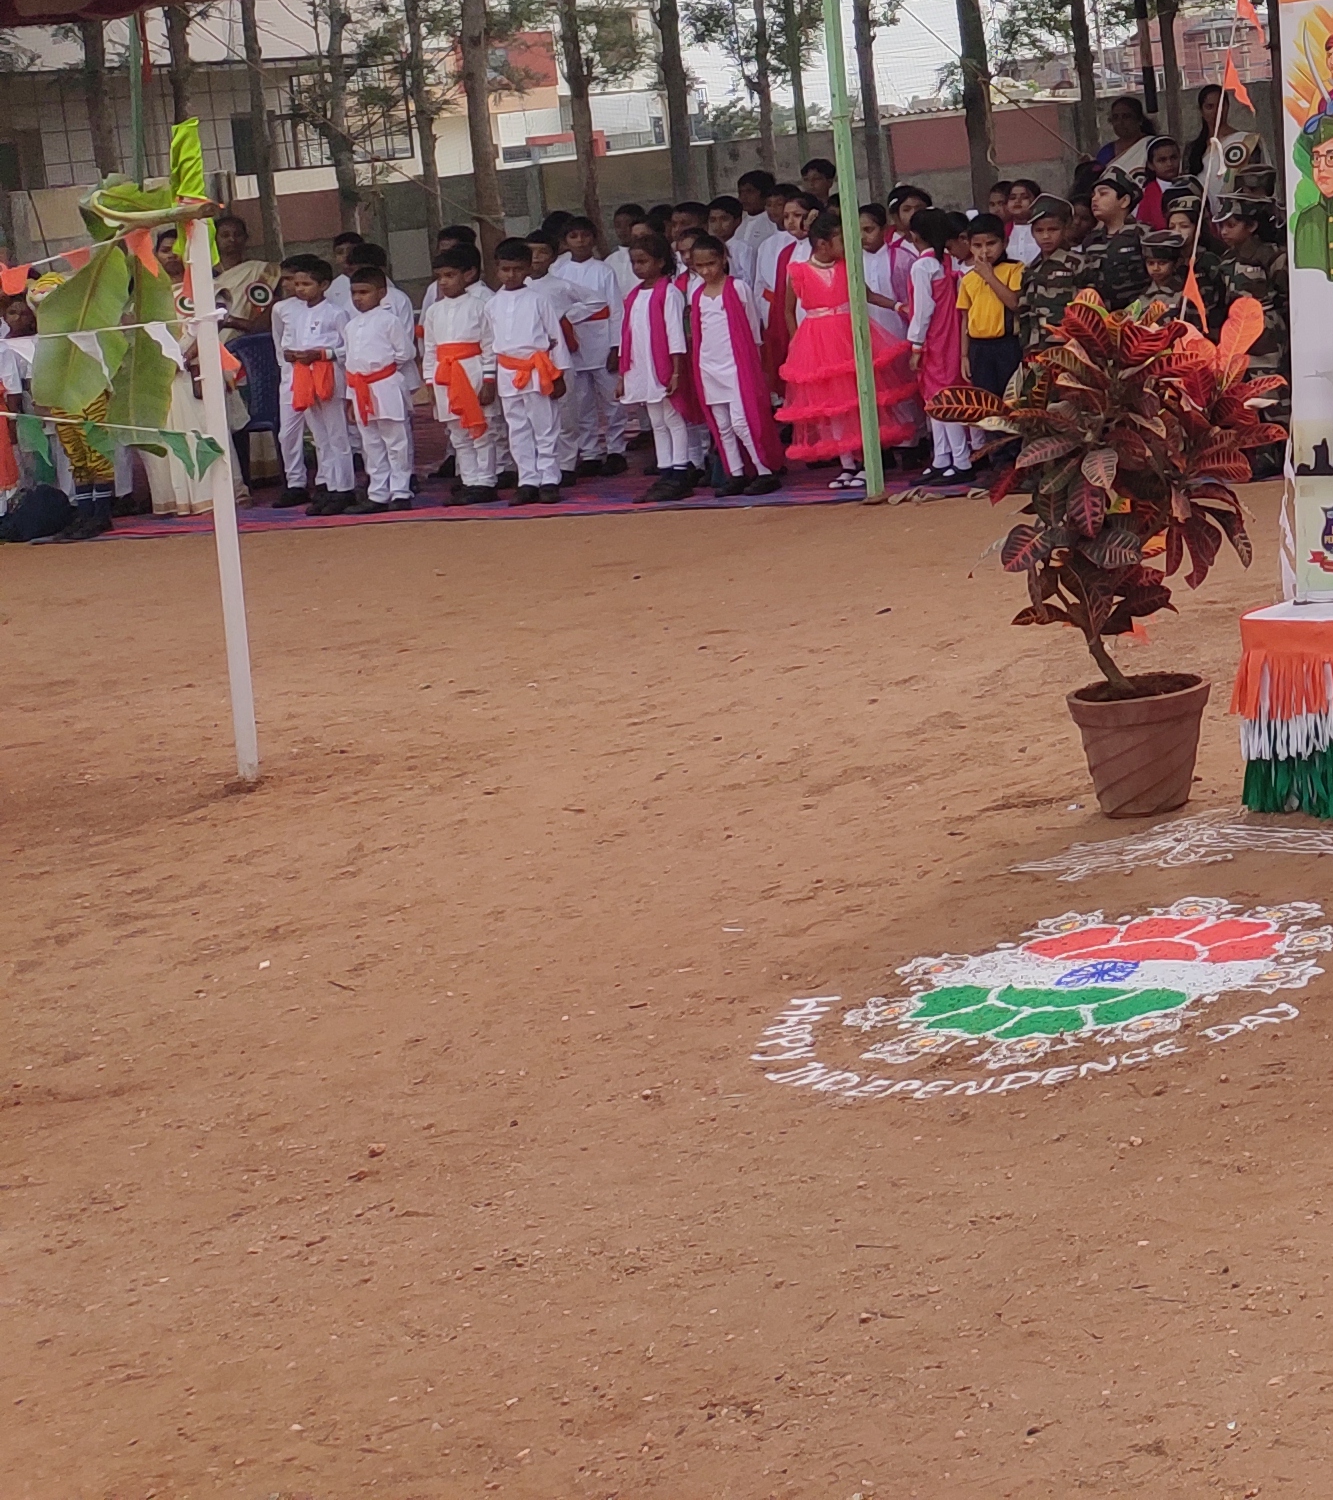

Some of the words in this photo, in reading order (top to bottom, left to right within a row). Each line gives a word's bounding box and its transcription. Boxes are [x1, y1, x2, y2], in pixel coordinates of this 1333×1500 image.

[750, 995, 842, 1061] HAPPY
[1197, 1002, 1300, 1044] DAY
[764, 1038, 1188, 1099] INDEPENDENCE
